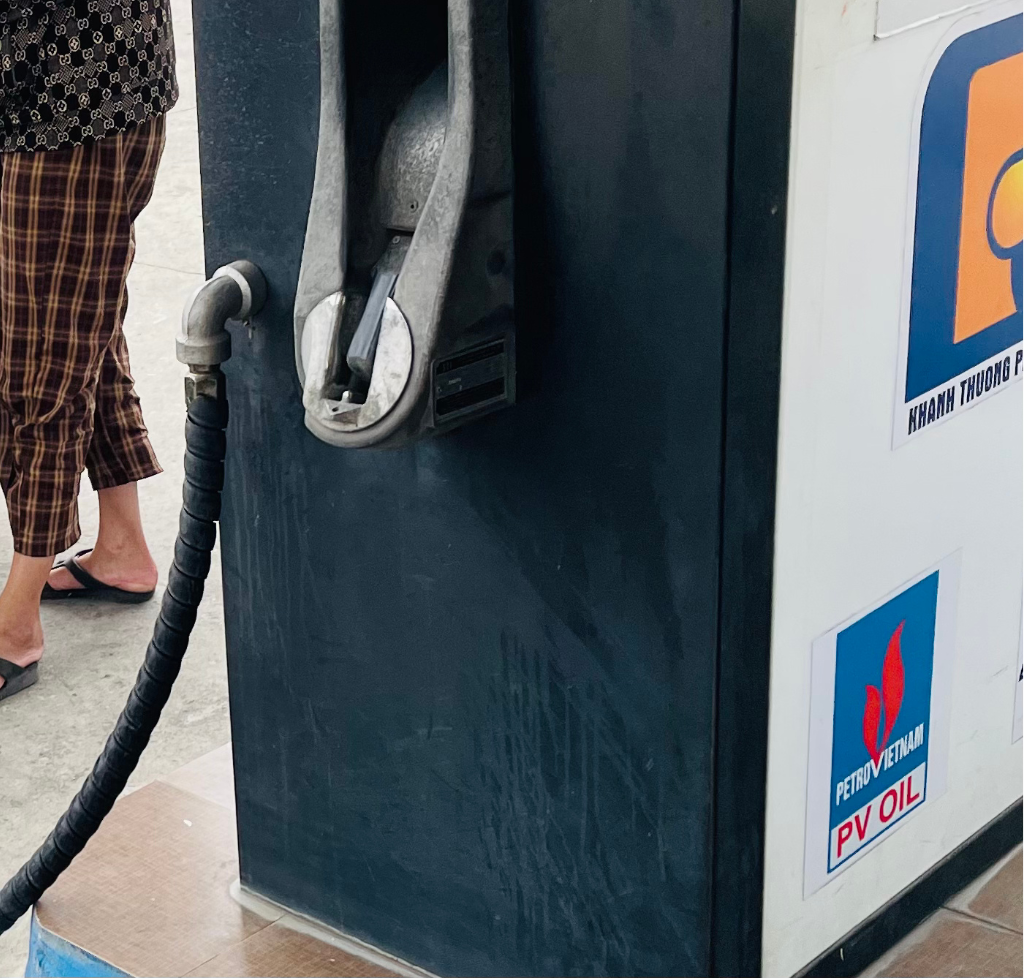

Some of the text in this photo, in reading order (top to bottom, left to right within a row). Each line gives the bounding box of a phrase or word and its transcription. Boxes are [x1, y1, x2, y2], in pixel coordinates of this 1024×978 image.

[908, 349, 1023, 436] KHANH THUONG P
[835, 722, 925, 806] PETROVIETNAM
[836, 775, 920, 859] PV OIL
